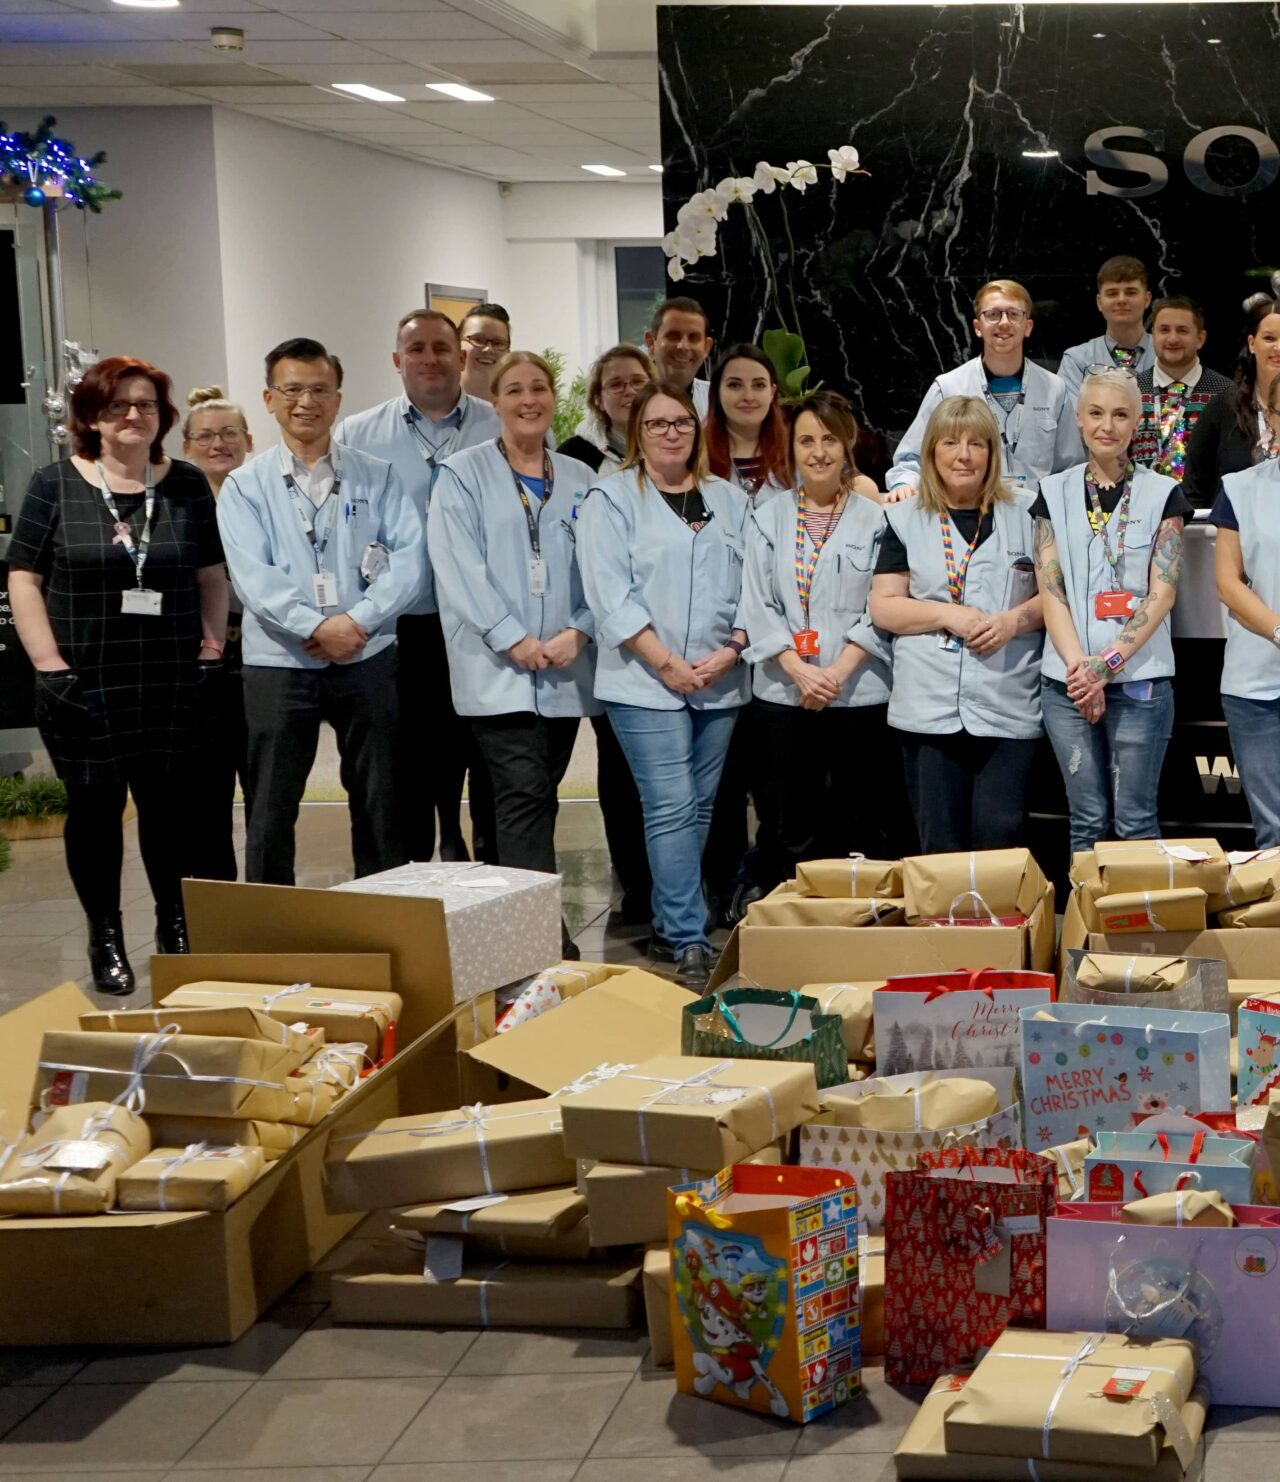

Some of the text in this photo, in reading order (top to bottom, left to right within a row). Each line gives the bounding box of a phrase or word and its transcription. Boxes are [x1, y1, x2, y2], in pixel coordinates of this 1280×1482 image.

[952, 1020, 1019, 1040] Christ
[1046, 1067, 1104, 1092] MERRY
[1030, 1084, 1132, 1115] CHRISTMAS
